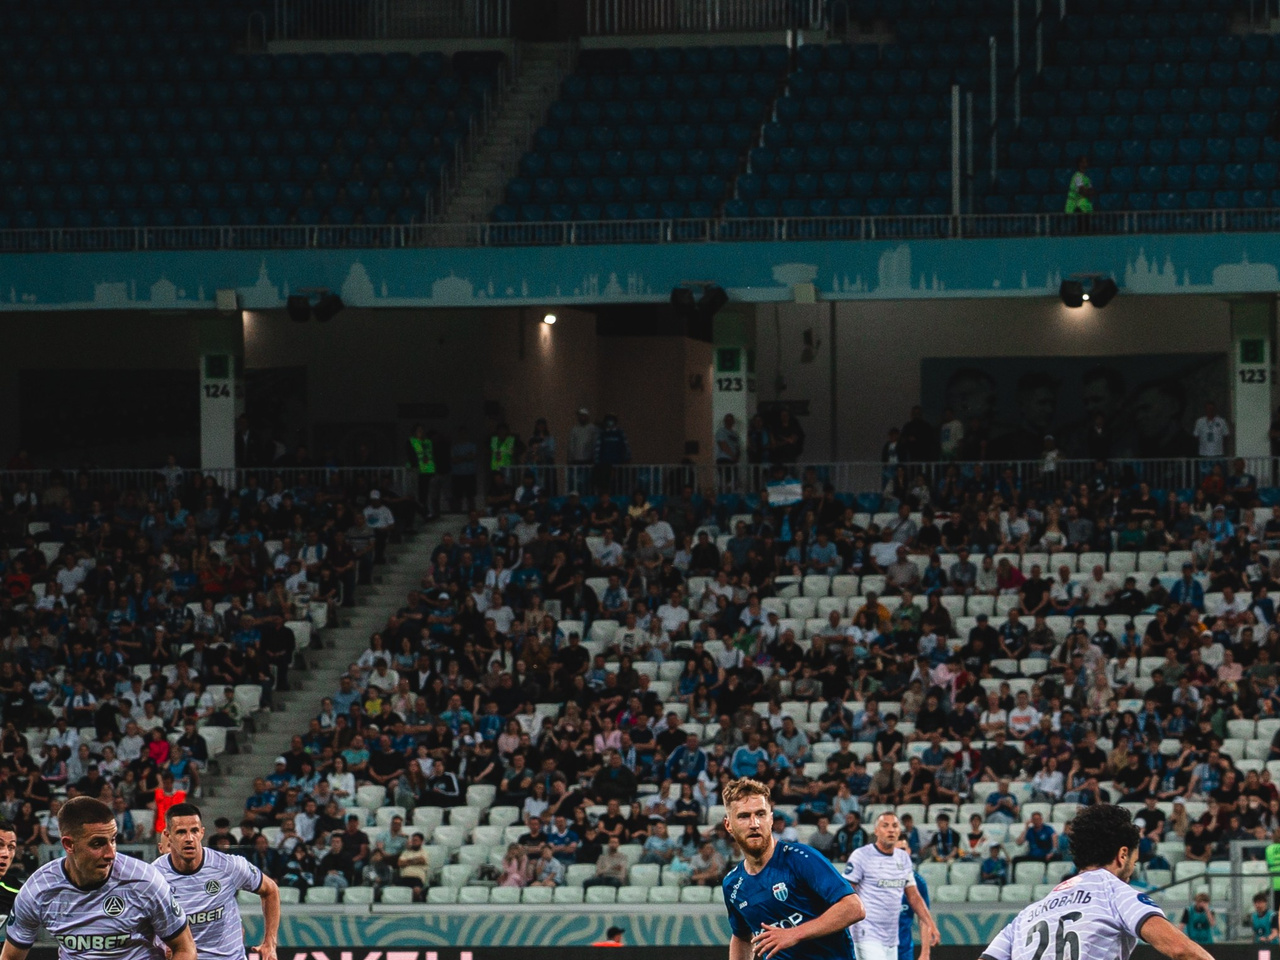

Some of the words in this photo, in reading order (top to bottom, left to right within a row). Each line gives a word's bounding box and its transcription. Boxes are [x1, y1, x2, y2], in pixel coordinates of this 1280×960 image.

[1239, 370, 1266, 383] 123
[204, 384, 230, 398] 124
[717, 378, 743, 392] 123
[186, 906, 225, 925] NBET
